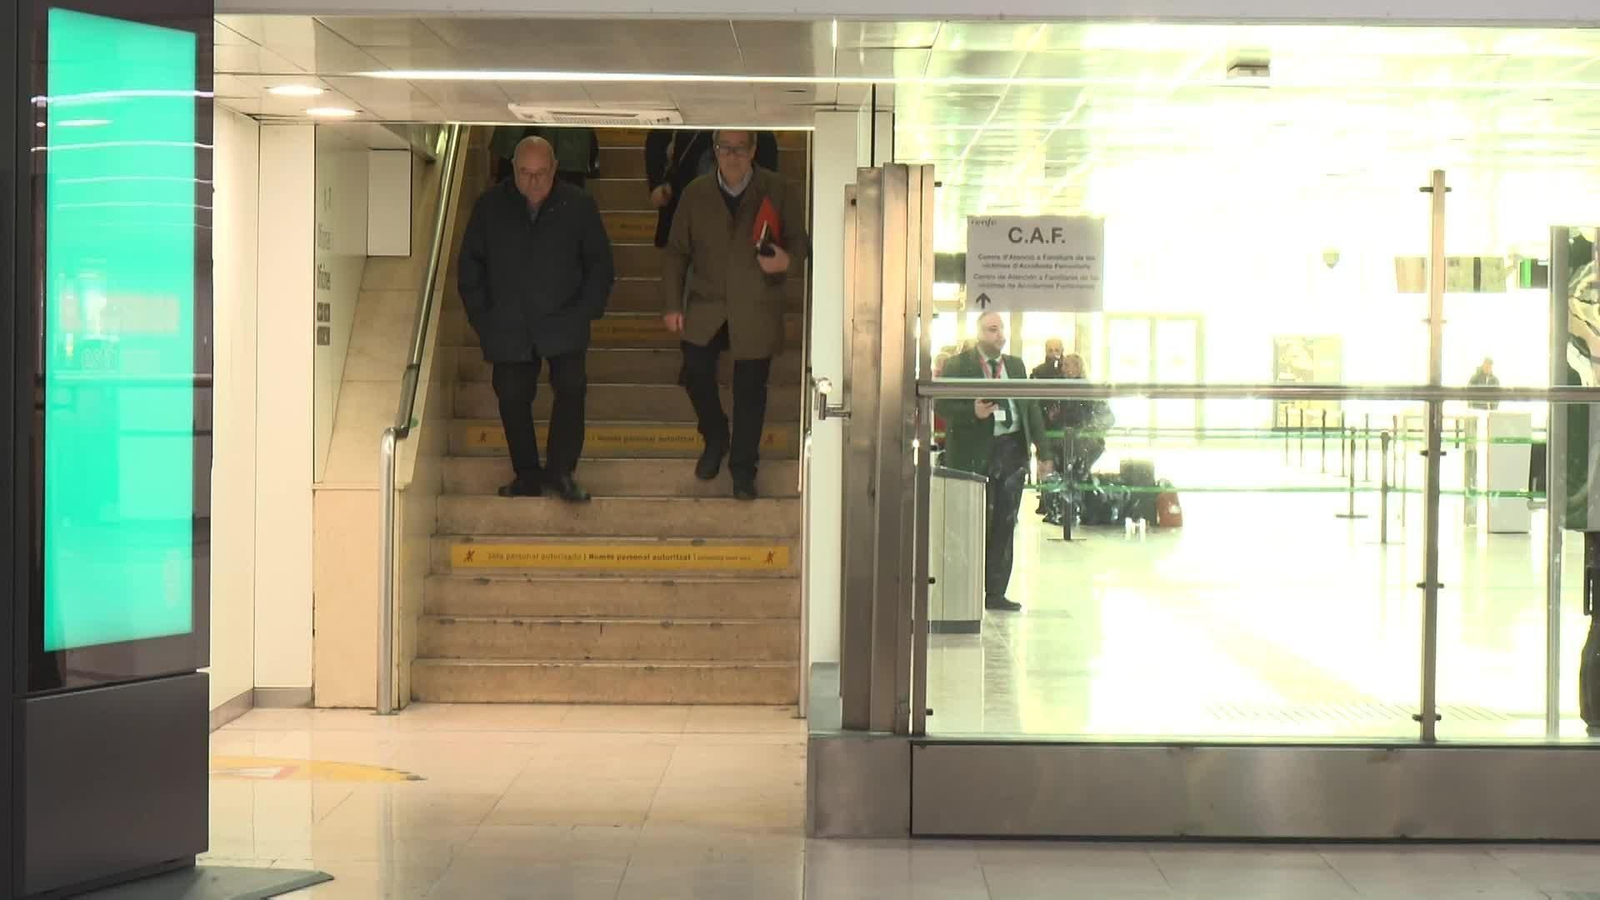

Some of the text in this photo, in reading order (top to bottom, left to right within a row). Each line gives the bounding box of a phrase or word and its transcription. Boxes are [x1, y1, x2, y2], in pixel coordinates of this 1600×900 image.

[1008, 226, 1066, 244] C.A.F.
[506, 552, 538, 562] personal
[616, 552, 650, 562] personal
[652, 552, 691, 561] autoritzat
